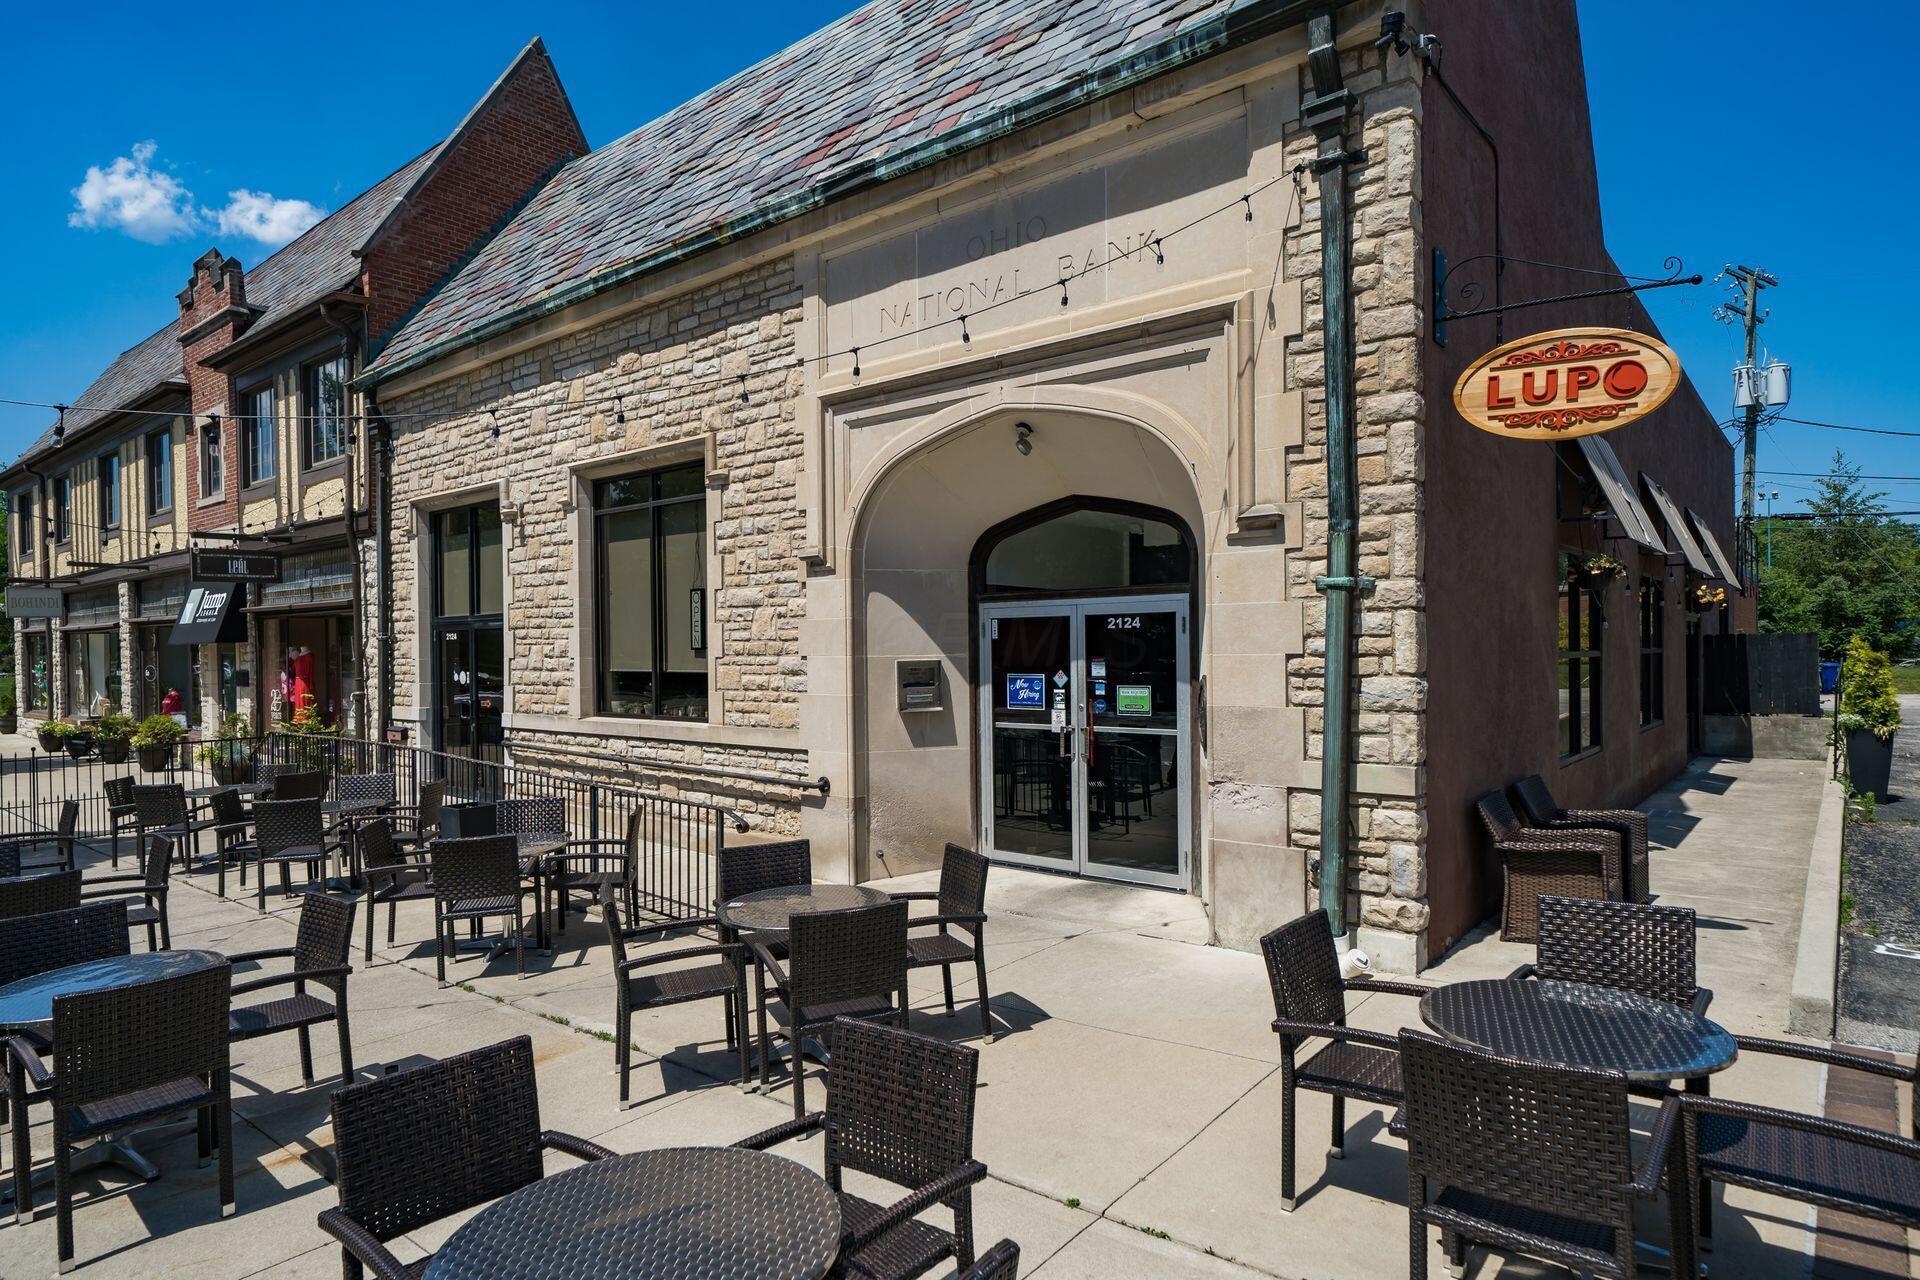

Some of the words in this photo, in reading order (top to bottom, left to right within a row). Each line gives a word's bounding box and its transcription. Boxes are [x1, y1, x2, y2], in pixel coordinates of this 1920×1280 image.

[966, 215, 1047, 262] OHIO
[879, 268, 1031, 333] NATIONAL
[1058, 229, 1159, 281] BANK
[1487, 360, 1648, 411] LUPO
[196, 591, 227, 617] Jump
[1106, 617, 1141, 629] 2124
[1010, 679, 1029, 691] Now
[1017, 689, 1040, 701] Hiring
